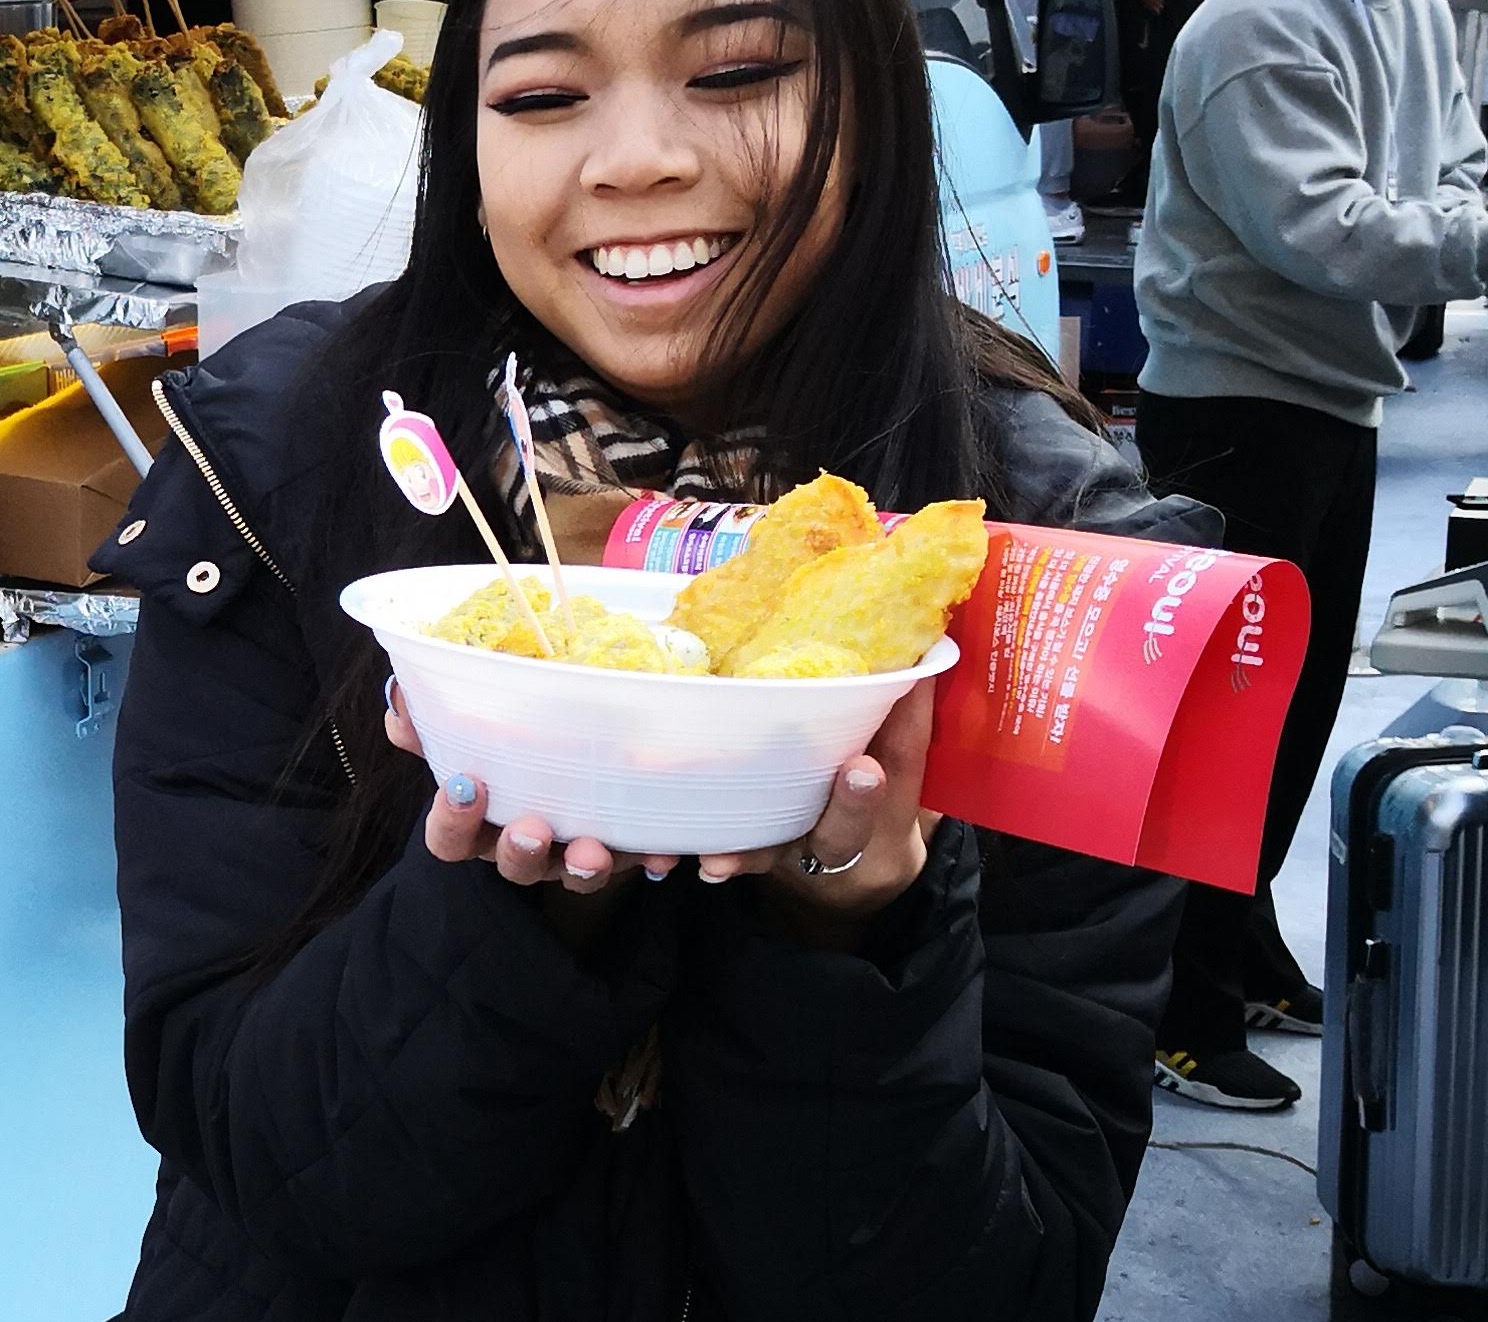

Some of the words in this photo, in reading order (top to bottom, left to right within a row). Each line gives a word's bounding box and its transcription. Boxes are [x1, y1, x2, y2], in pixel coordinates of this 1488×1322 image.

[1093, 560, 1125, 601] 영수증
[1072, 604, 1102, 660] 모으고!
[1059, 664, 1079, 699] 선물
[1048, 701, 1070, 743] 받자!
